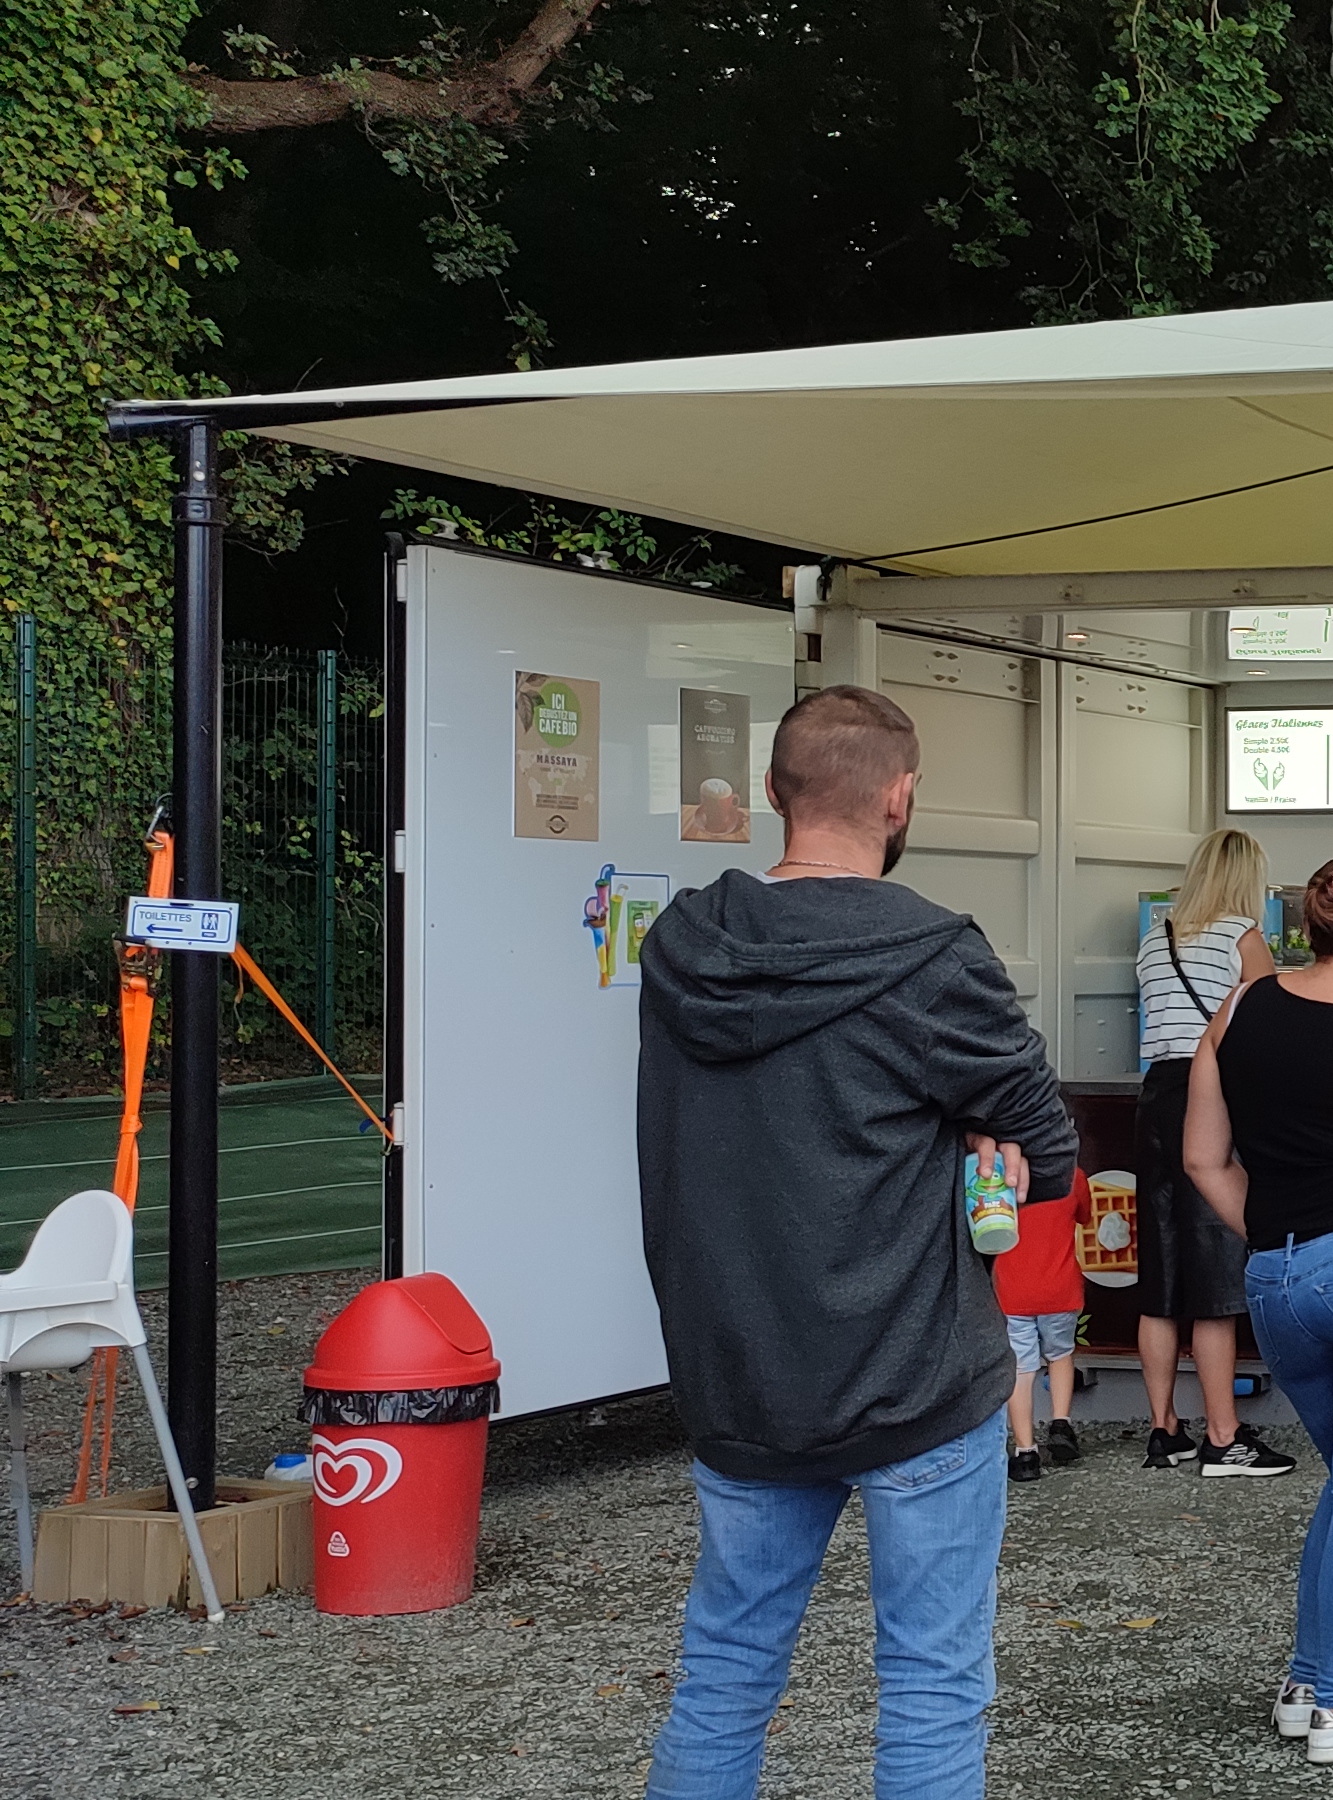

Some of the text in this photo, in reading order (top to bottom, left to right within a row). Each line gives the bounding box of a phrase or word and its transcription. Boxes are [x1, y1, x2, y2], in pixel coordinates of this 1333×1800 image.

[552, 693, 565, 710] ICI
[561, 721, 577, 736] BIO
[1236, 719, 1269, 730] Glaces
[536, 754, 577, 767] MASSAYA
[139, 911, 191, 922] TOILETTES
